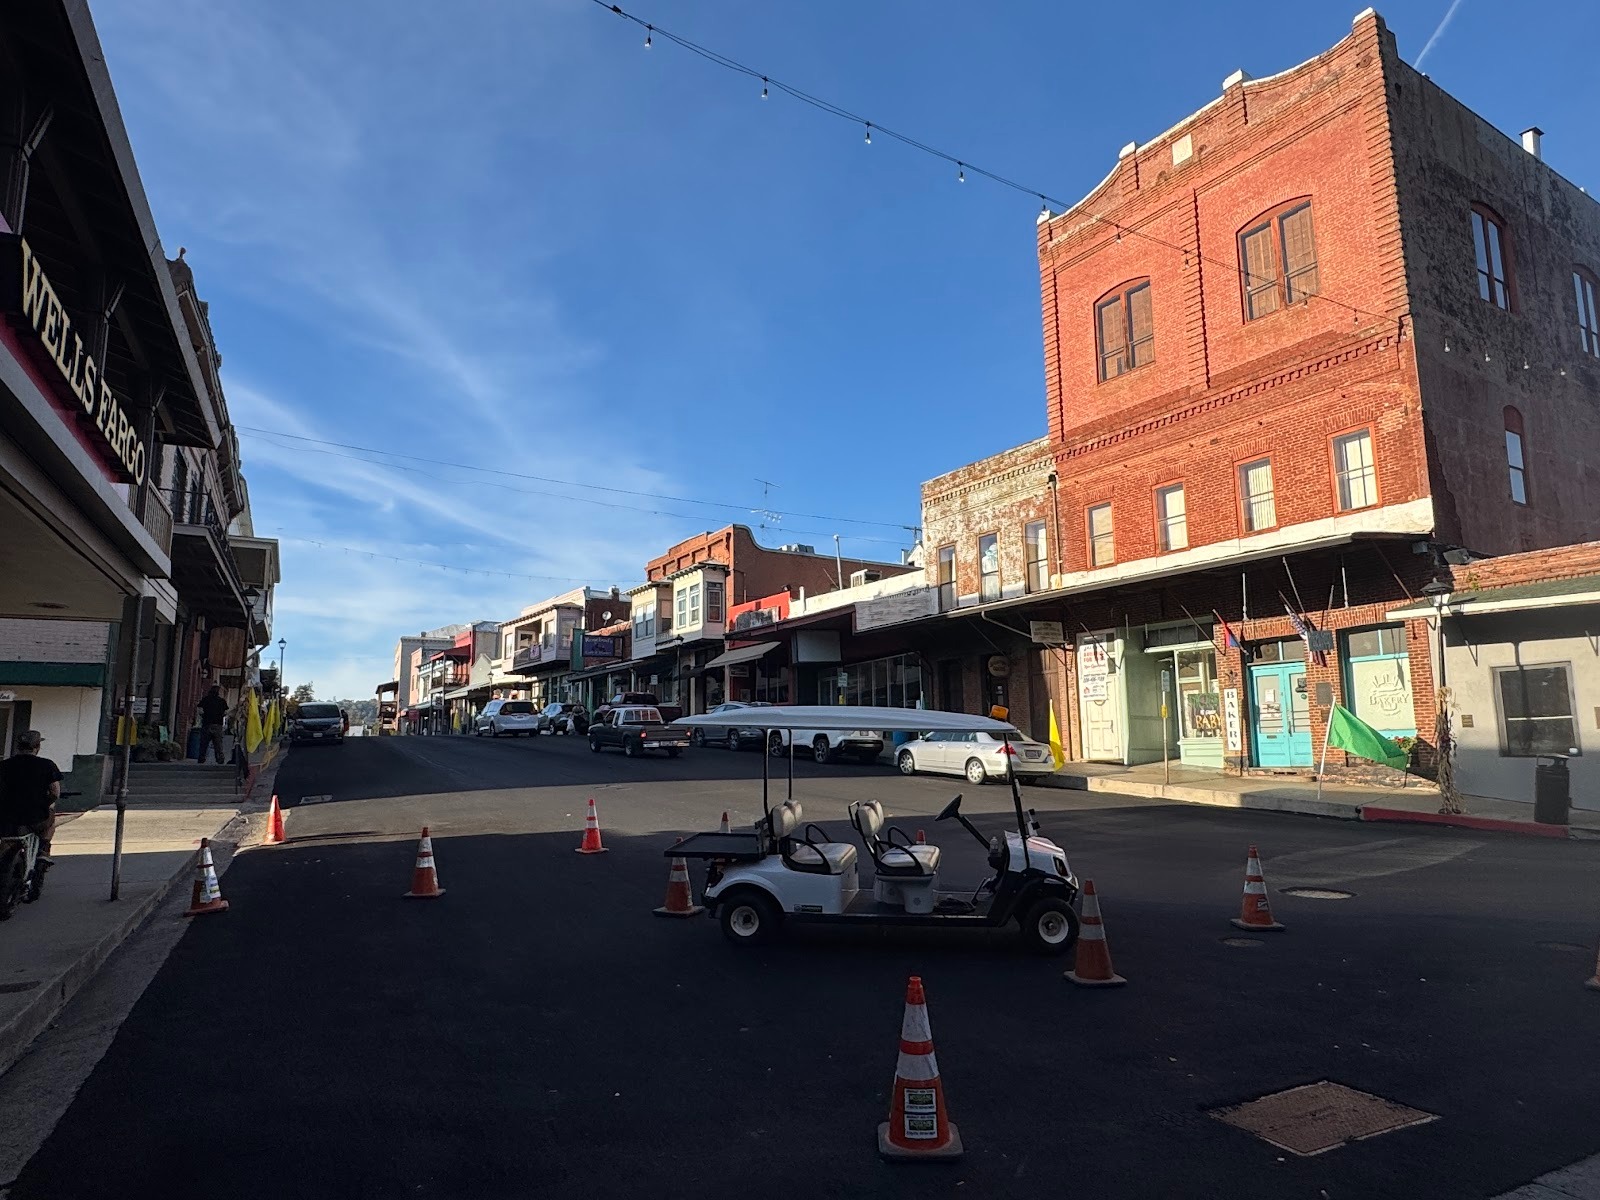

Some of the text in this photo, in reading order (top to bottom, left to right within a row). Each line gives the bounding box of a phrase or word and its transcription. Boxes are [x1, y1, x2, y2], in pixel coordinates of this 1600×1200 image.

[21, 237, 146, 486] WELLS FARGO
[1226, 691, 1238, 748] BAKERY
[1369, 693, 1410, 706] BAKERY
